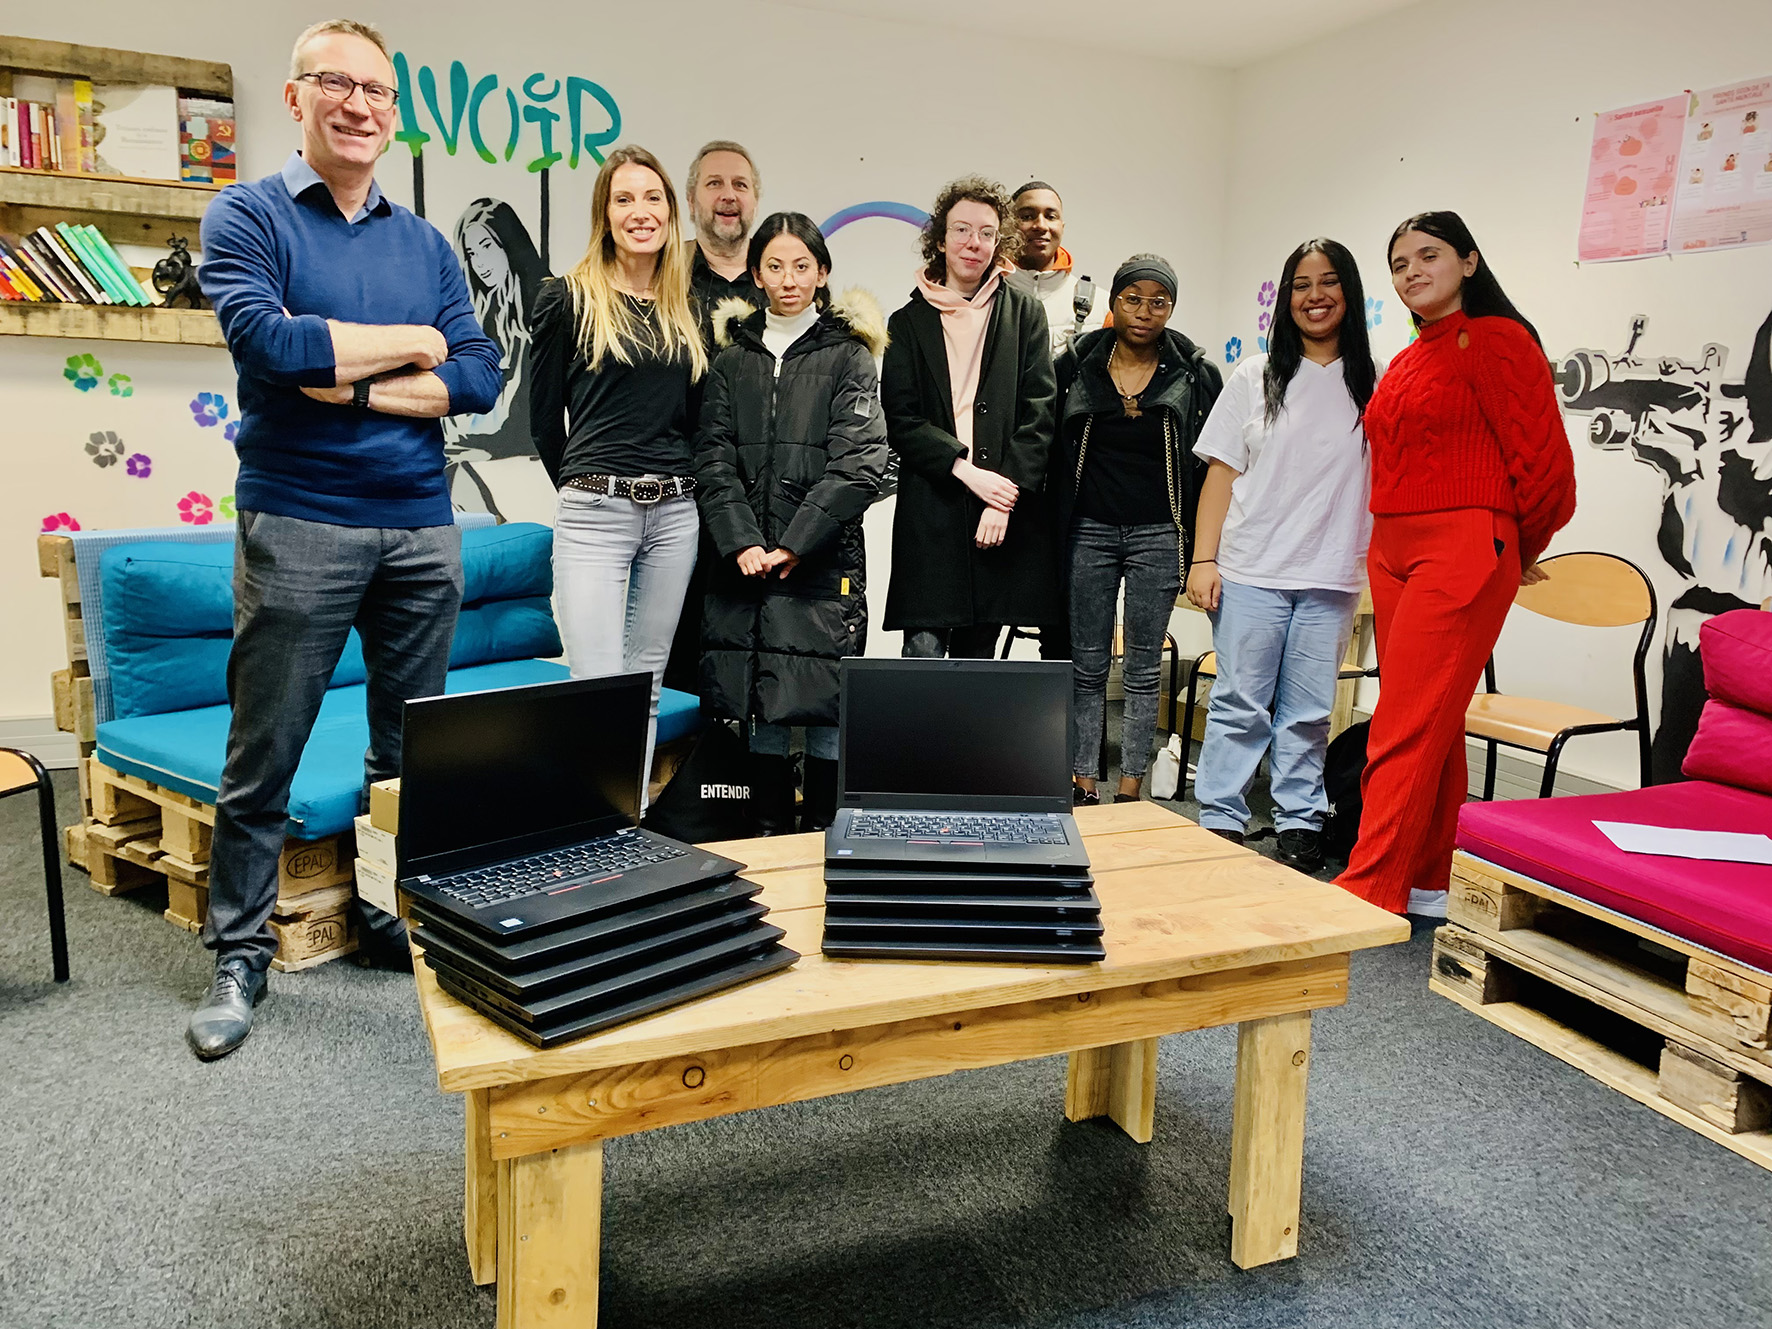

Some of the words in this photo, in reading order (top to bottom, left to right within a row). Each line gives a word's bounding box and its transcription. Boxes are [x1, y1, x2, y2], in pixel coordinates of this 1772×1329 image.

[700, 784, 750, 799] ENTENDR
[294, 853, 328, 874] EPAL
[305, 925, 336, 948] EPAL
